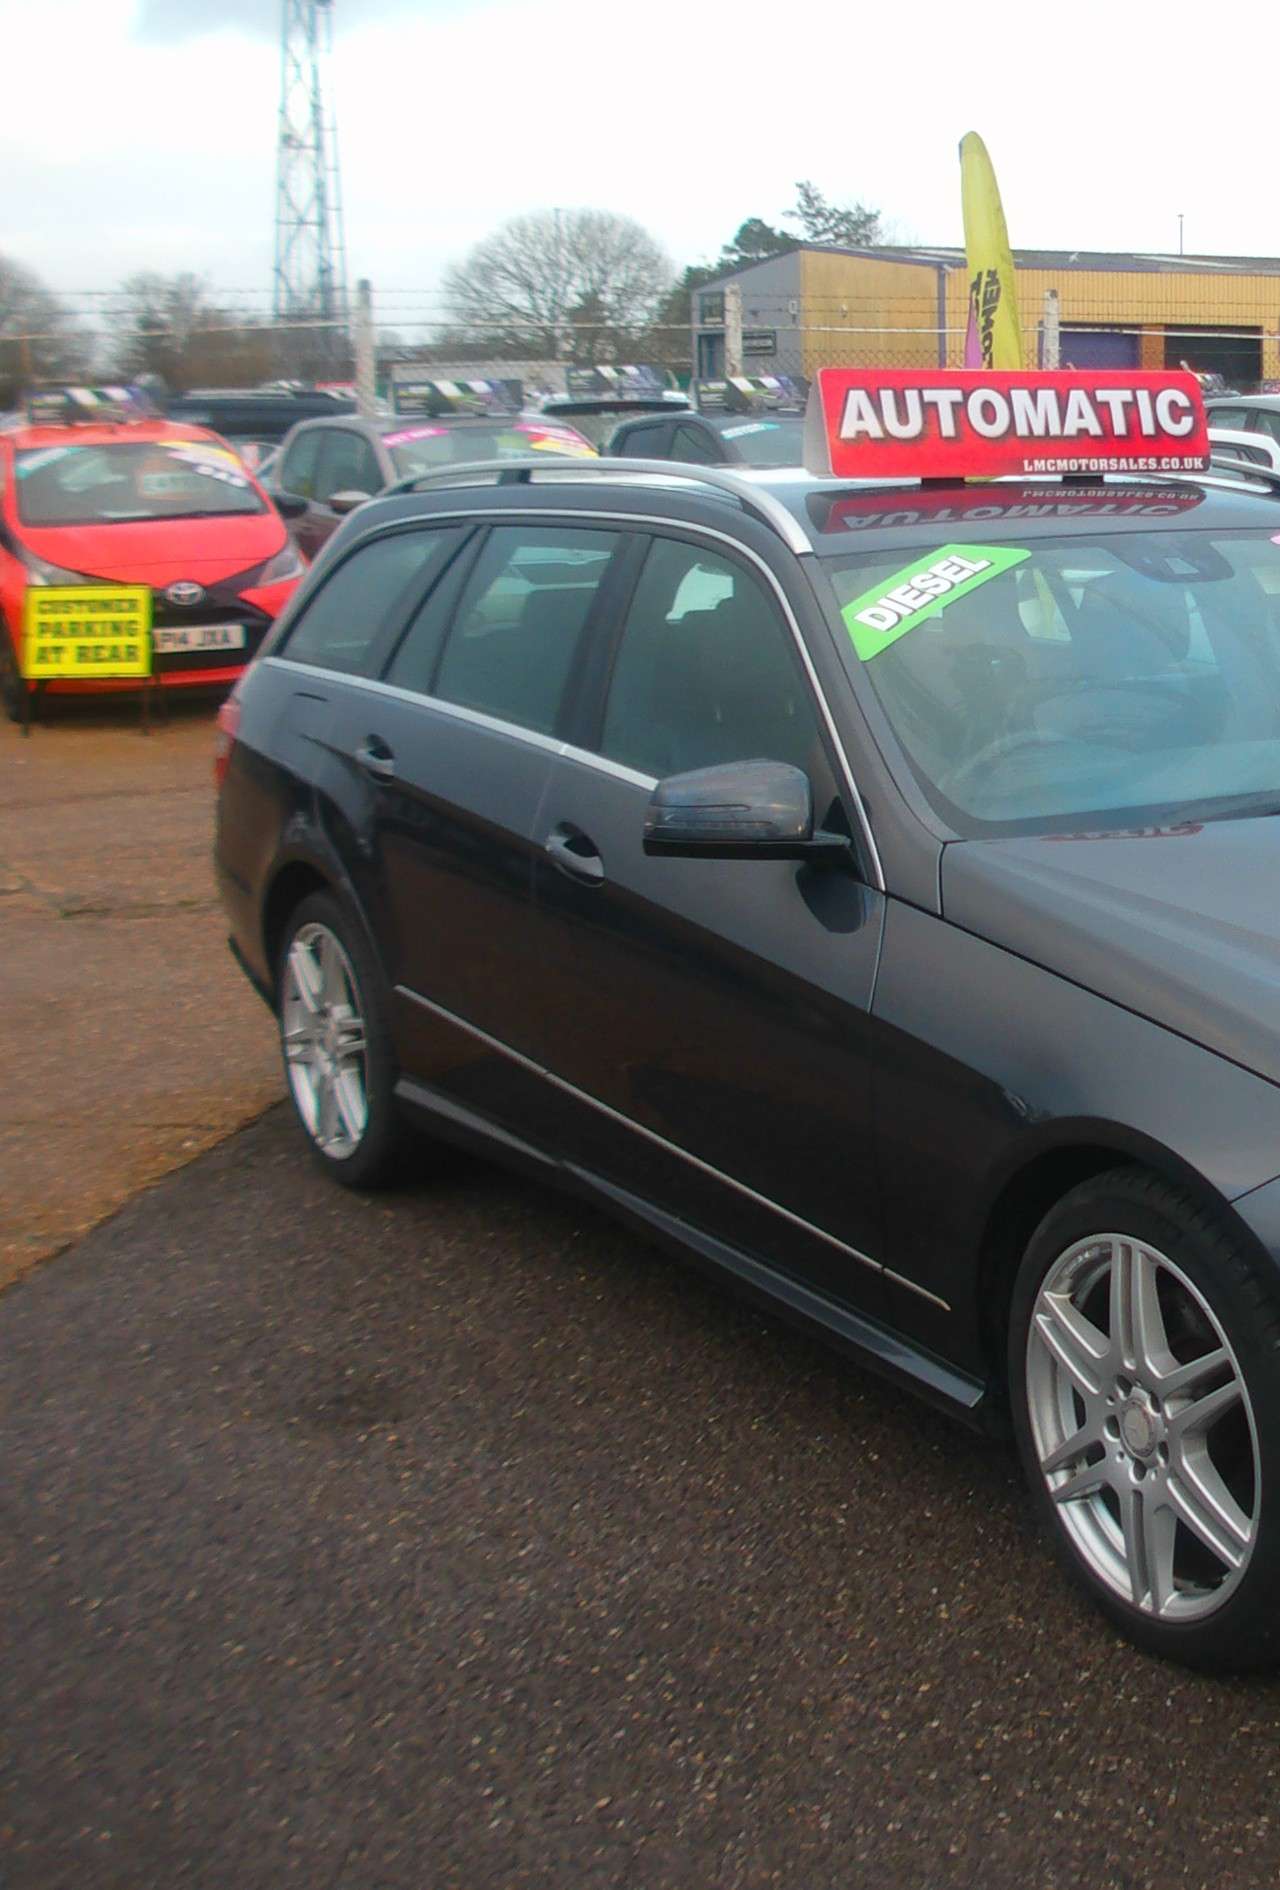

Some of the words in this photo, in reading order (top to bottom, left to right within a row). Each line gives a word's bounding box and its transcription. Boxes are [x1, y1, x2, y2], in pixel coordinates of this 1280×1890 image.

[839, 388, 1194, 439] AUTOMATIC
[1023, 457, 1204, 472] LMCMOTORSALES.CO.UK
[854, 555, 990, 632] DIESEL
[36, 620, 139, 638] PARKING
[36, 647, 63, 664] AT
[76, 646, 140, 664] REAR
